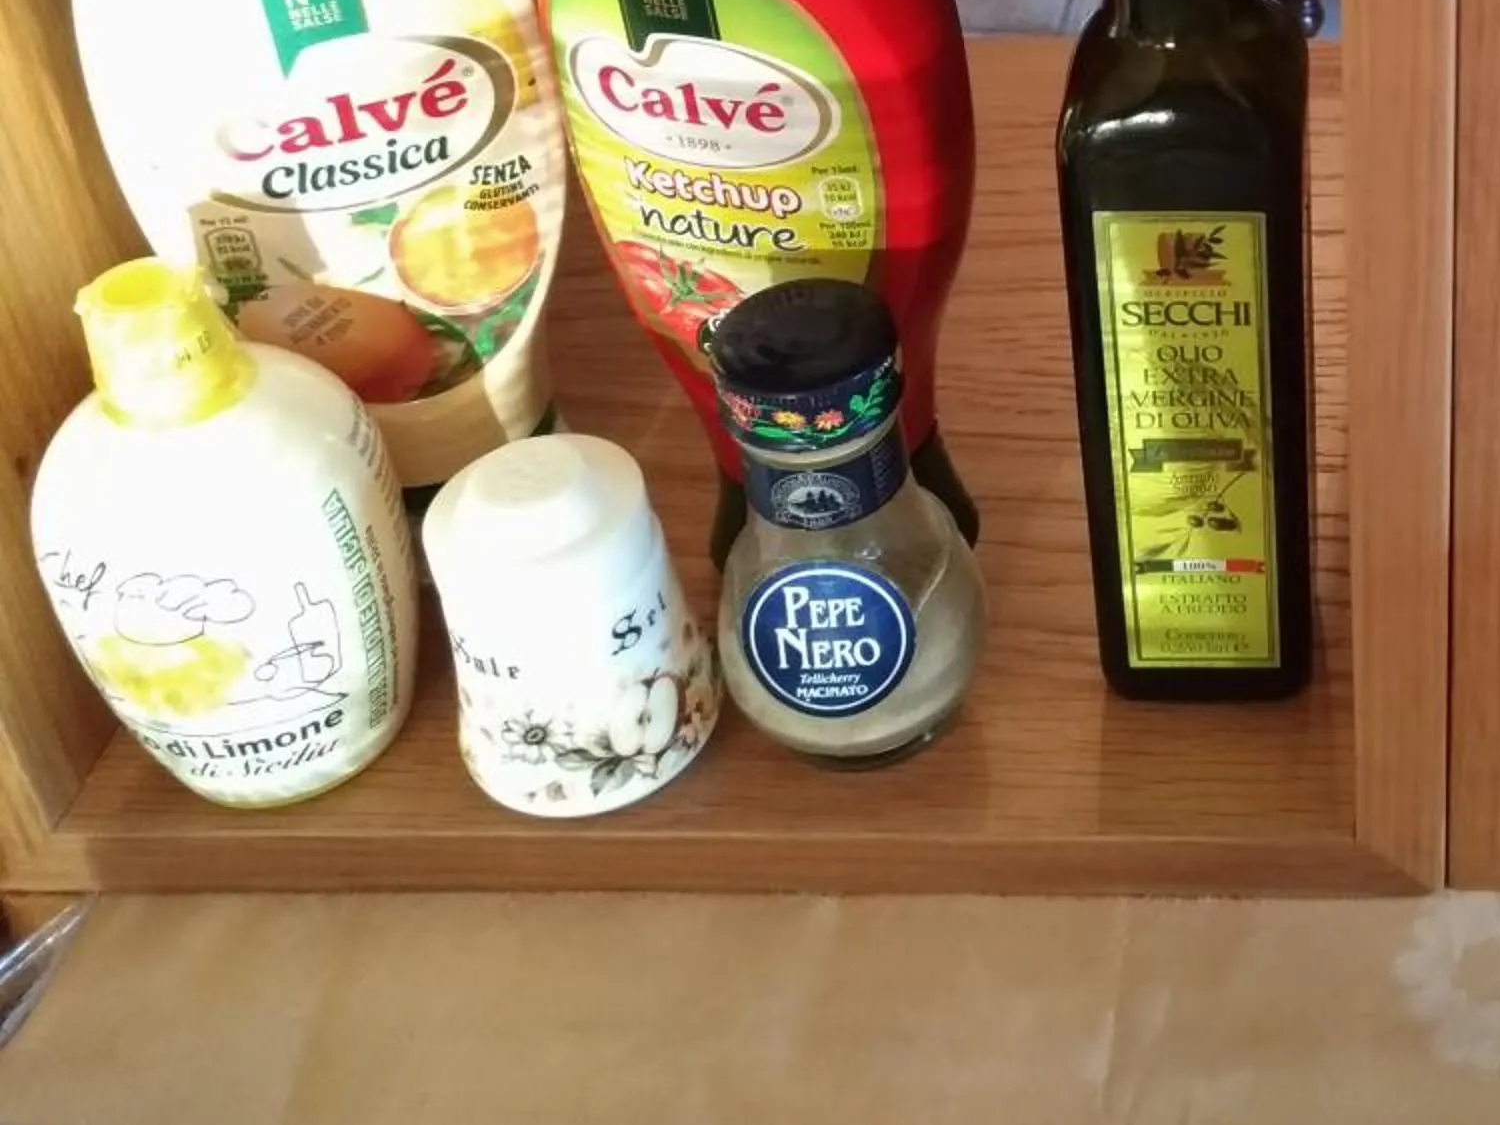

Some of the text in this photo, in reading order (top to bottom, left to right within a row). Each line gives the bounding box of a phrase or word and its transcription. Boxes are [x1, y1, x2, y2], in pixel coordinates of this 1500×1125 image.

[598, 65, 788, 133] Calvé
[261, 135, 449, 200] Classica
[469, 155, 532, 185] SENZA
[623, 155, 803, 220] Ketchup
[639, 205, 808, 252] nature
[1121, 300, 1252, 327] SECCHI
[1156, 344, 1224, 363] OLIO
[1143, 368, 1240, 386] EXTRA
[1135, 412, 1251, 430] DI OLIVA
[774, 627, 882, 671] NERO
[796, 684, 870, 698] MACINATO
[165, 739, 198, 759] di
[202, 708, 345, 760] Limone
